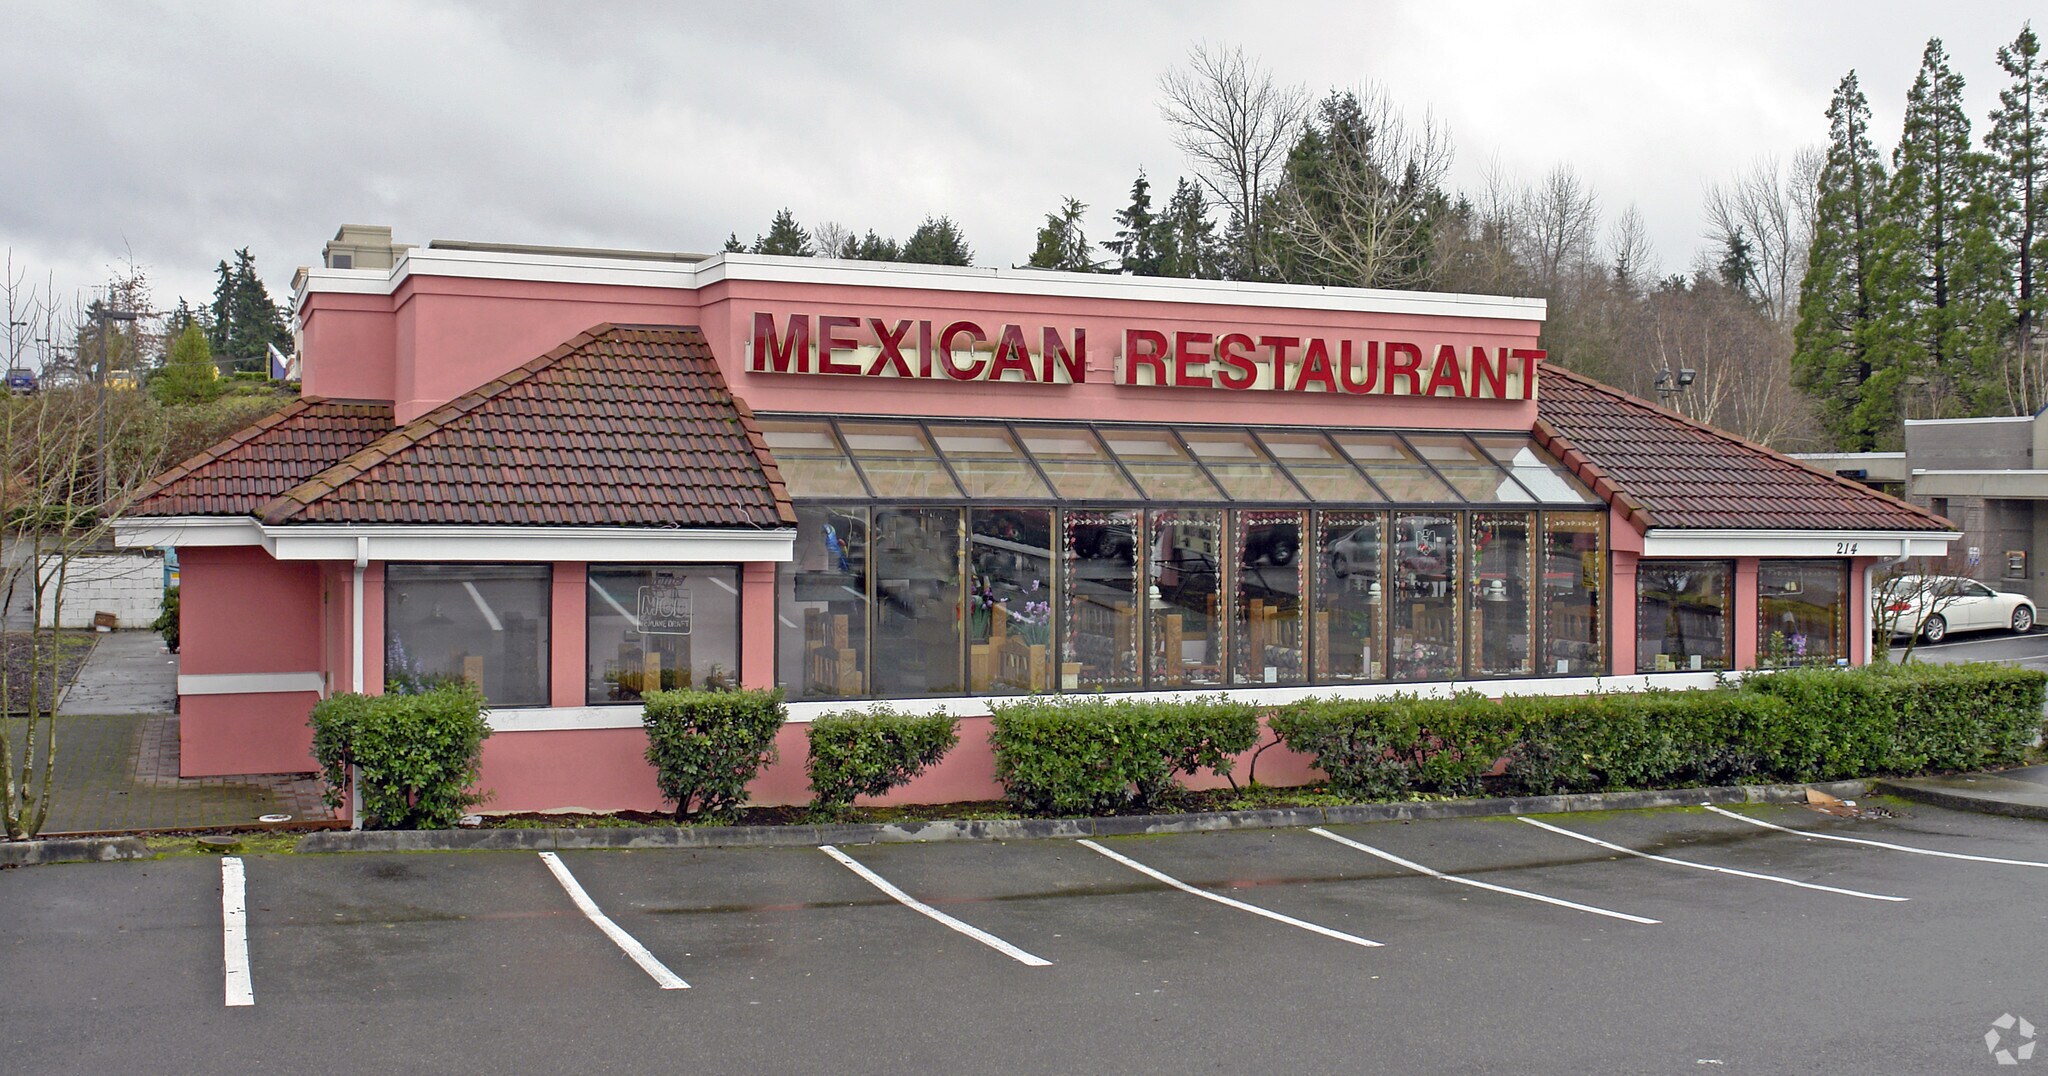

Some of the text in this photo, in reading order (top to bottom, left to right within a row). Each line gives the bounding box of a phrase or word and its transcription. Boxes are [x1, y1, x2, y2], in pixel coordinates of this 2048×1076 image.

[751, 311, 1547, 400] MEXICAN RESTAURANT
[1836, 541, 1858, 554] 214
